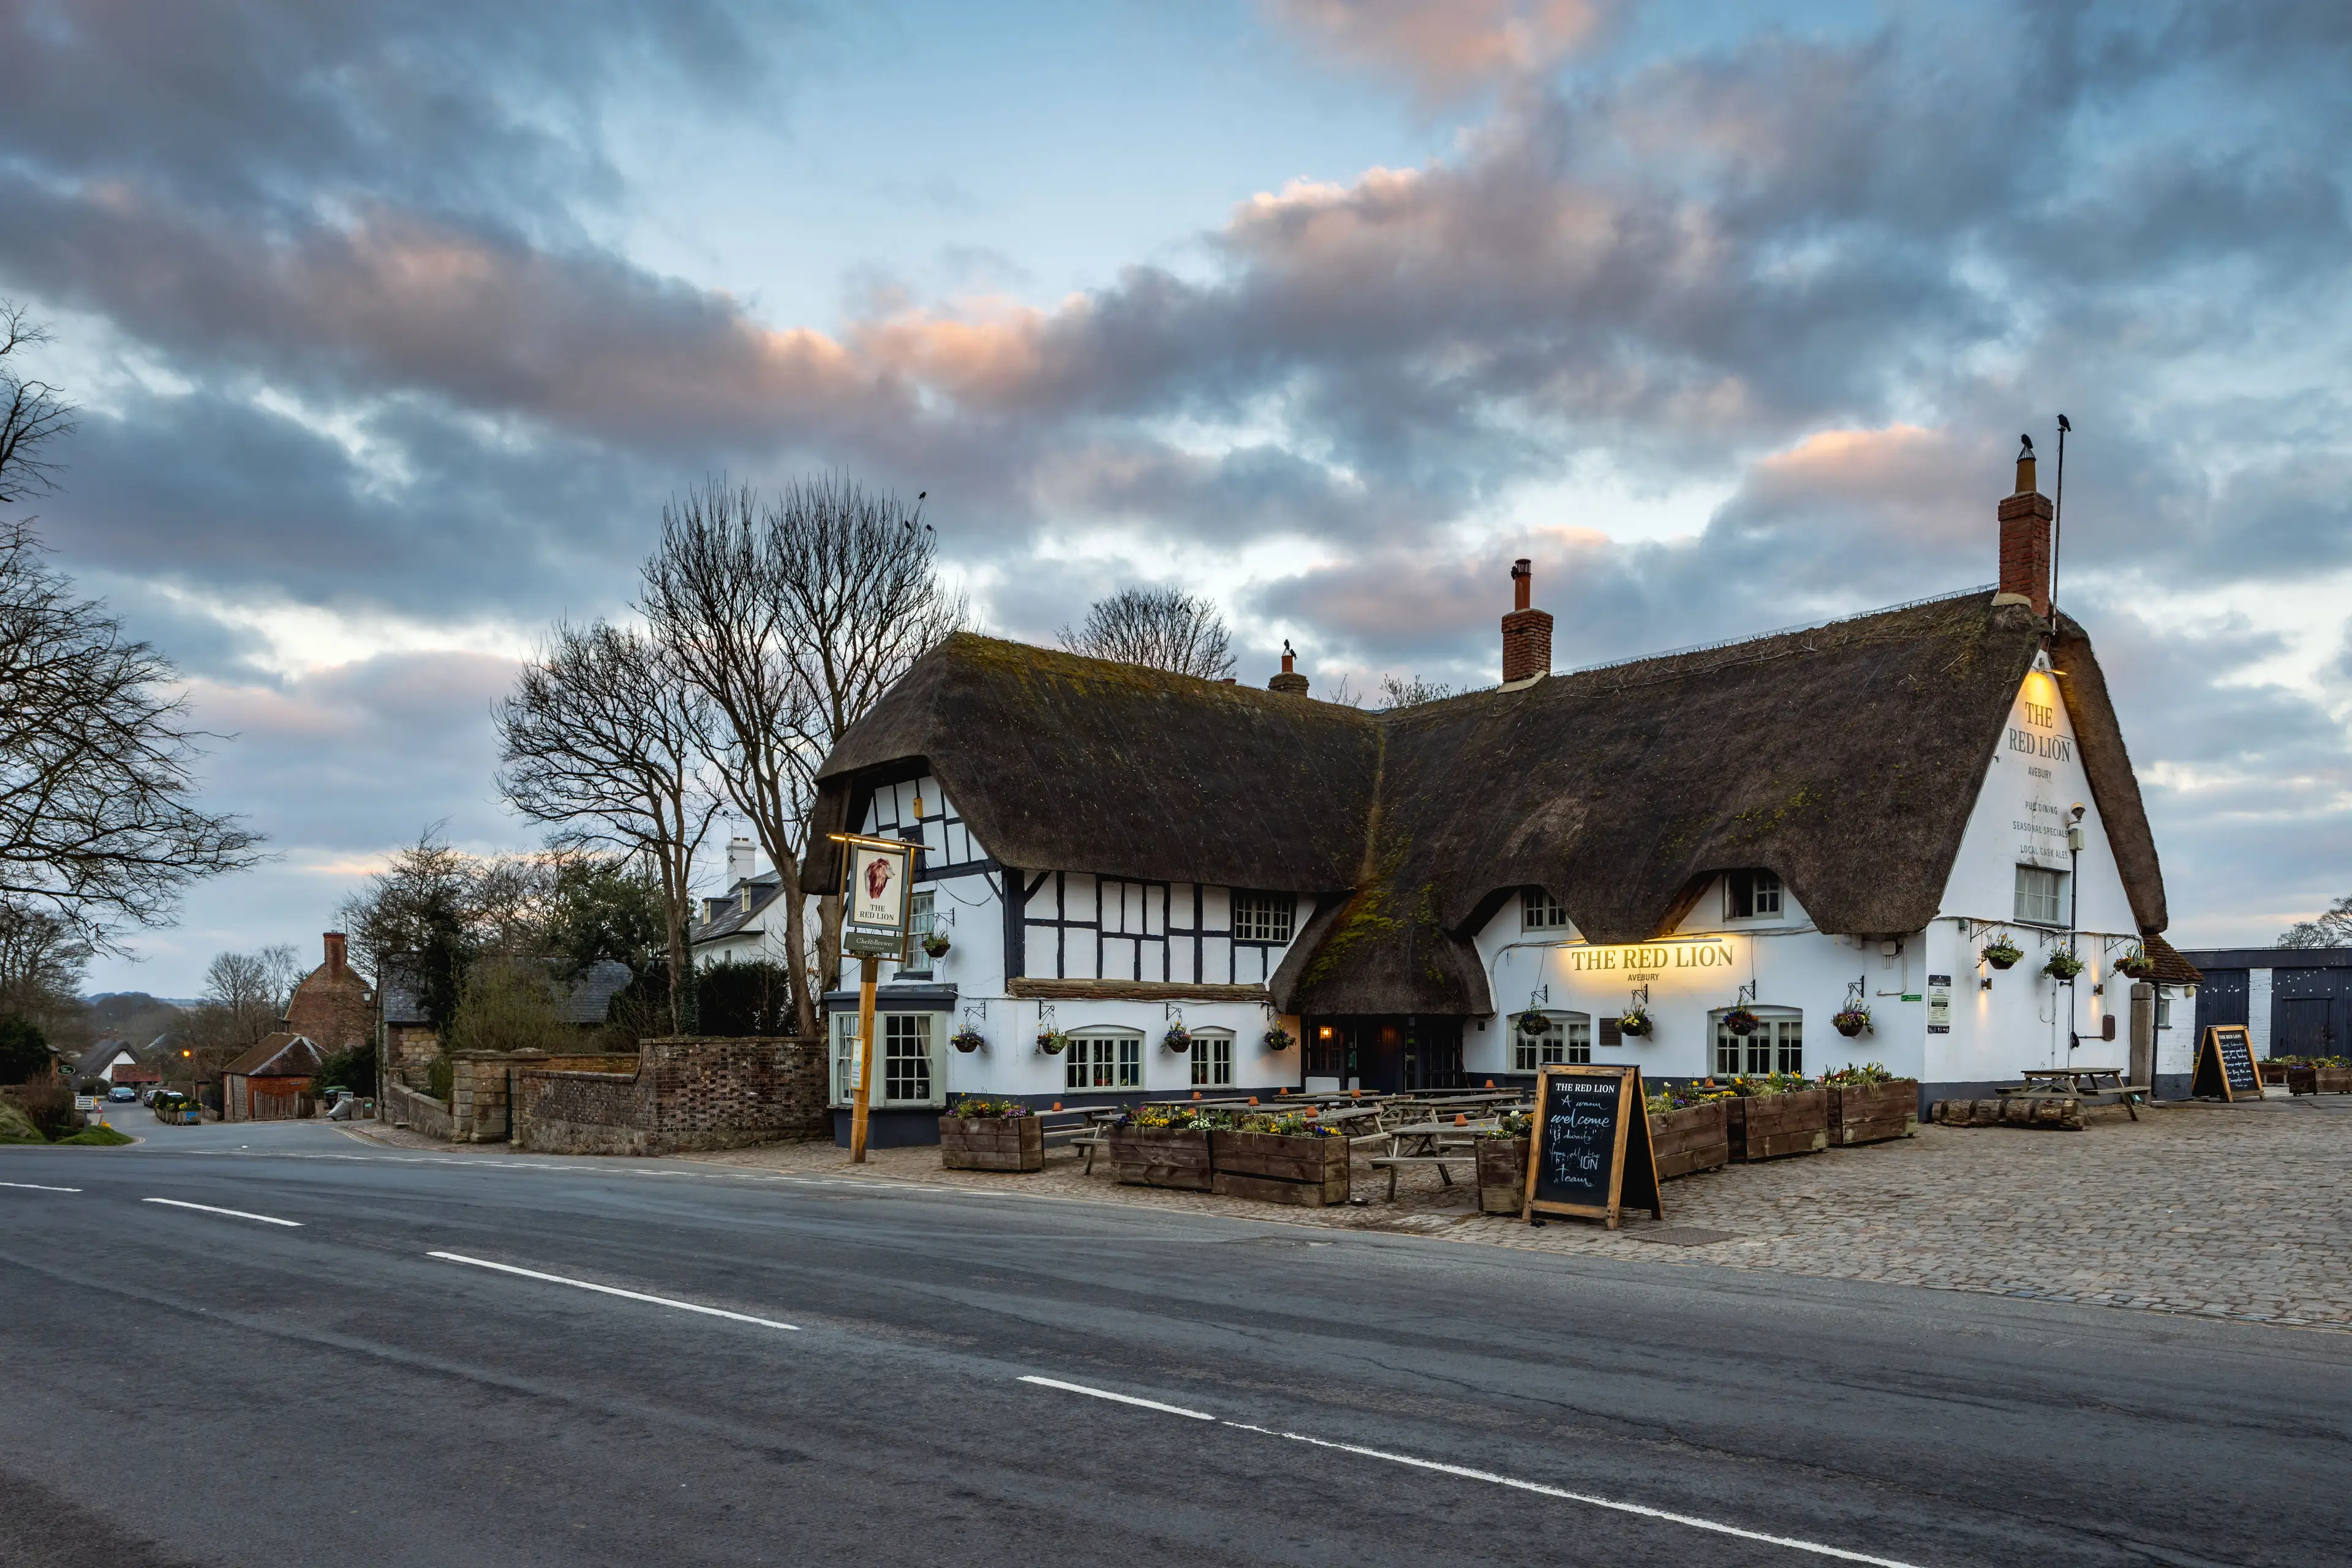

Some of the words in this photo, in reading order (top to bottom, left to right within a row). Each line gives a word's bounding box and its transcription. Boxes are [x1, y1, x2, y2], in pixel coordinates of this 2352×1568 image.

[2025, 701, 2052, 729] THE
[2009, 728, 2035, 755] RED
[2039, 736, 2070, 763] LION
[2028, 767, 2052, 780] AVEBURY
[2025, 801, 2037, 811] PUB
[2038, 804, 2057, 815] DINING
[2013, 821, 2041, 834] SEASONAL
[2043, 826, 2068, 838] SPECIALS
[2020, 845, 2038, 854] LOCAL
[2040, 848, 2054, 858] CASK
[2056, 850, 2068, 859] ALES
[856, 937, 894, 947] Chef&Brewer
[1572, 950, 1616, 970] THE
[1623, 948, 1668, 969] RED
[1675, 945, 1735, 967] LION
[1556, 1083, 1573, 1091] THE
[1575, 1084, 1592, 1092] RED
[1594, 1084, 1615, 1093] LION
[1561, 1094, 1573, 1108] A
[1576, 1101, 1609, 1110] warm
[1550, 1108, 1611, 1128] welcome
[1549, 1142, 1566, 1165] from
